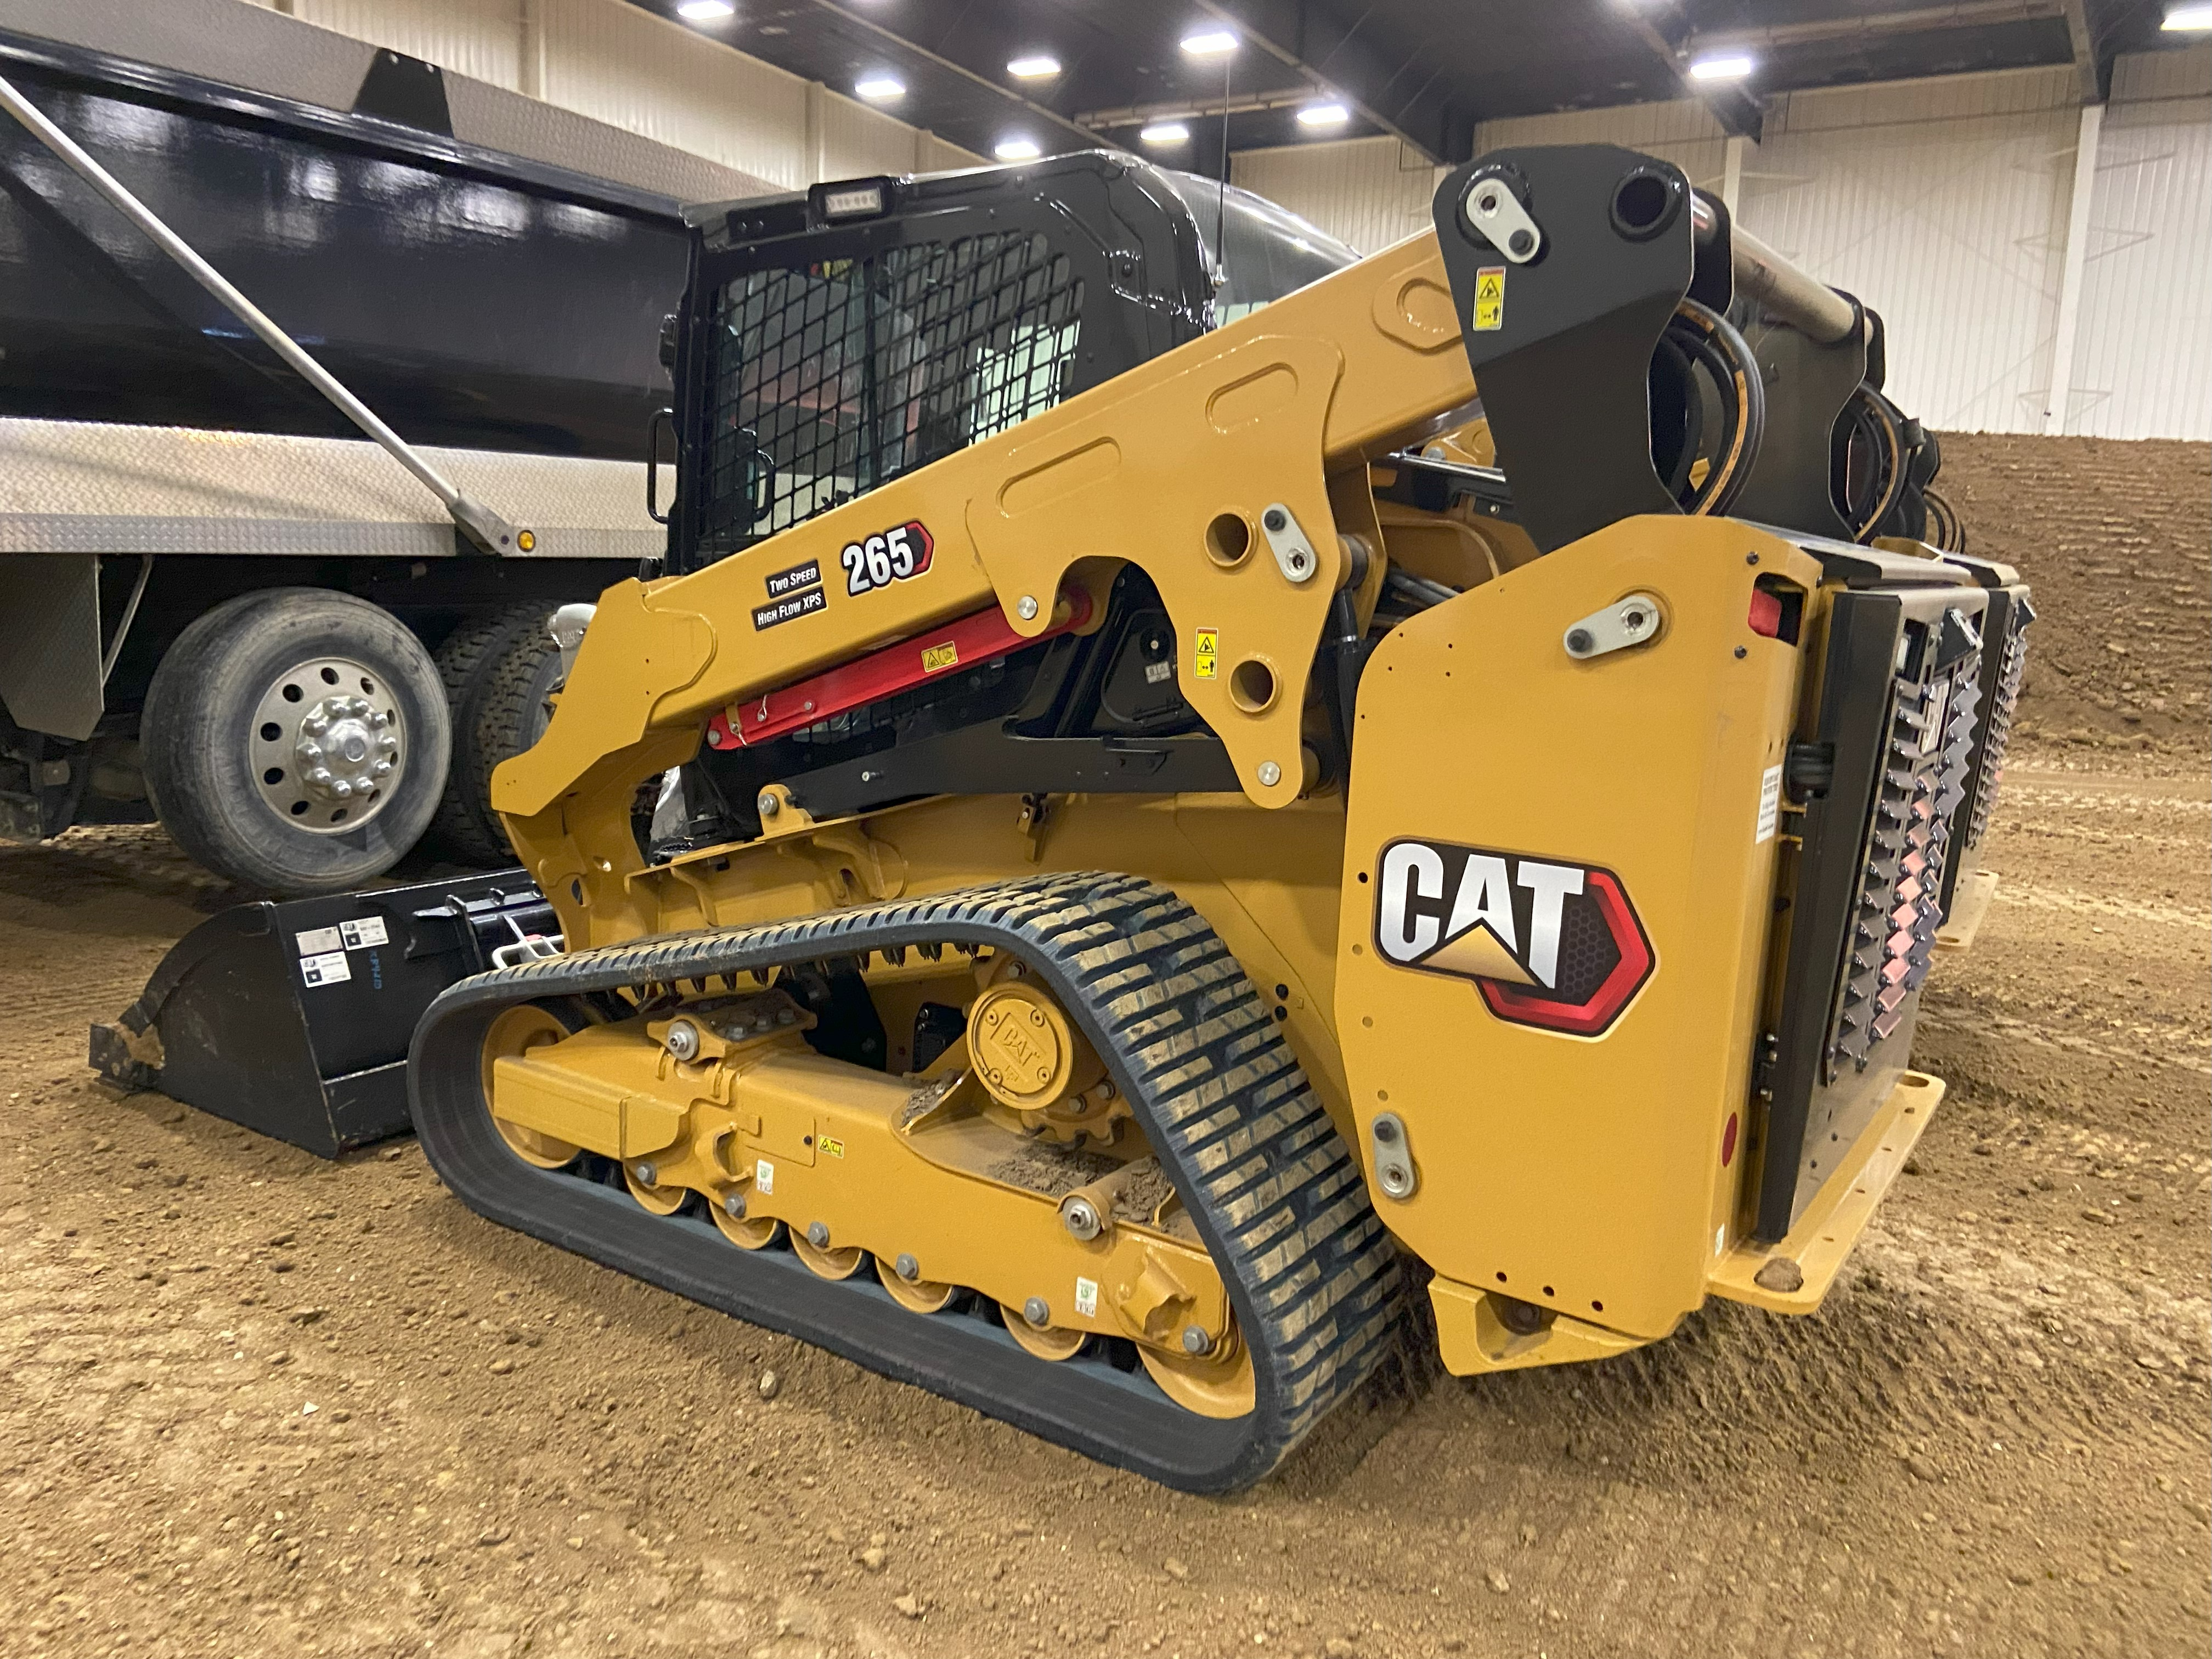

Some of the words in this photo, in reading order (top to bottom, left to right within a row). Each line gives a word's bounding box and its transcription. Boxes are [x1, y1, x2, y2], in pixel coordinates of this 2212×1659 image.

[769, 577, 788, 593] TWO
[790, 567, 816, 586] SPEED
[843, 527, 914, 593] 265
[757, 610, 778, 625] HIGH
[779, 601, 801, 618] FLOW
[803, 592, 822, 610] XPS
[1380, 843, 1584, 989] CAT
[1003, 1025, 1041, 1066] CAT
